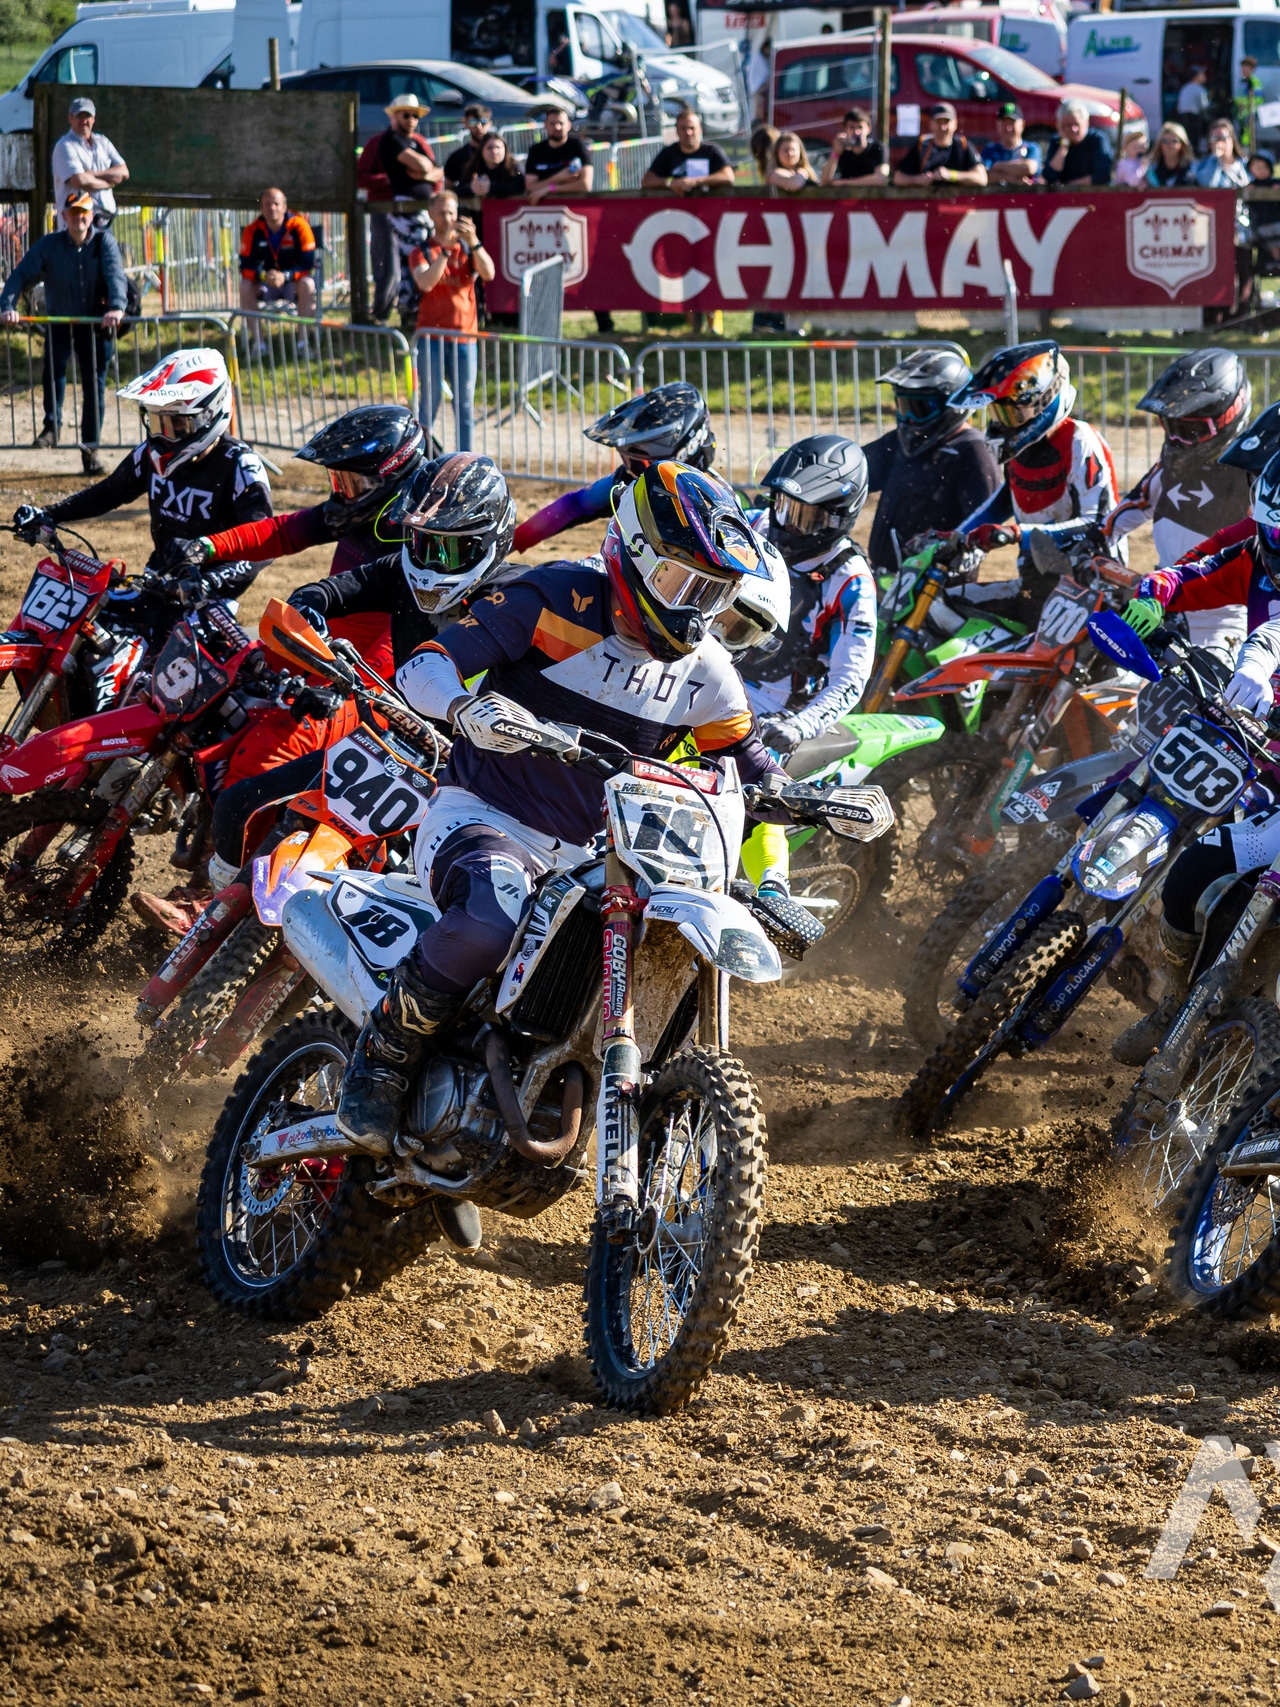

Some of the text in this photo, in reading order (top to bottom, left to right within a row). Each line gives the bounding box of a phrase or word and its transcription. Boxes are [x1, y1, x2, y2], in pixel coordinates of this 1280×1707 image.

[622, 207, 1089, 303] CHIMAY
[1139, 245, 1205, 259] CHIMAY
[151, 472, 214, 520] FXR
[1089, 621, 1127, 658] ACERBIS
[101, 737, 129, 746] MOTUL
[494, 721, 544, 744] ACERBIS
[1154, 732, 1239, 808] 503
[325, 747, 420, 838] 940
[816, 804, 872, 821] ACERBIS
[342, 904, 410, 948] 18
[612, 934, 628, 1017] GOBY Racing
[1063, 952, 1102, 996] FLOCAGE
